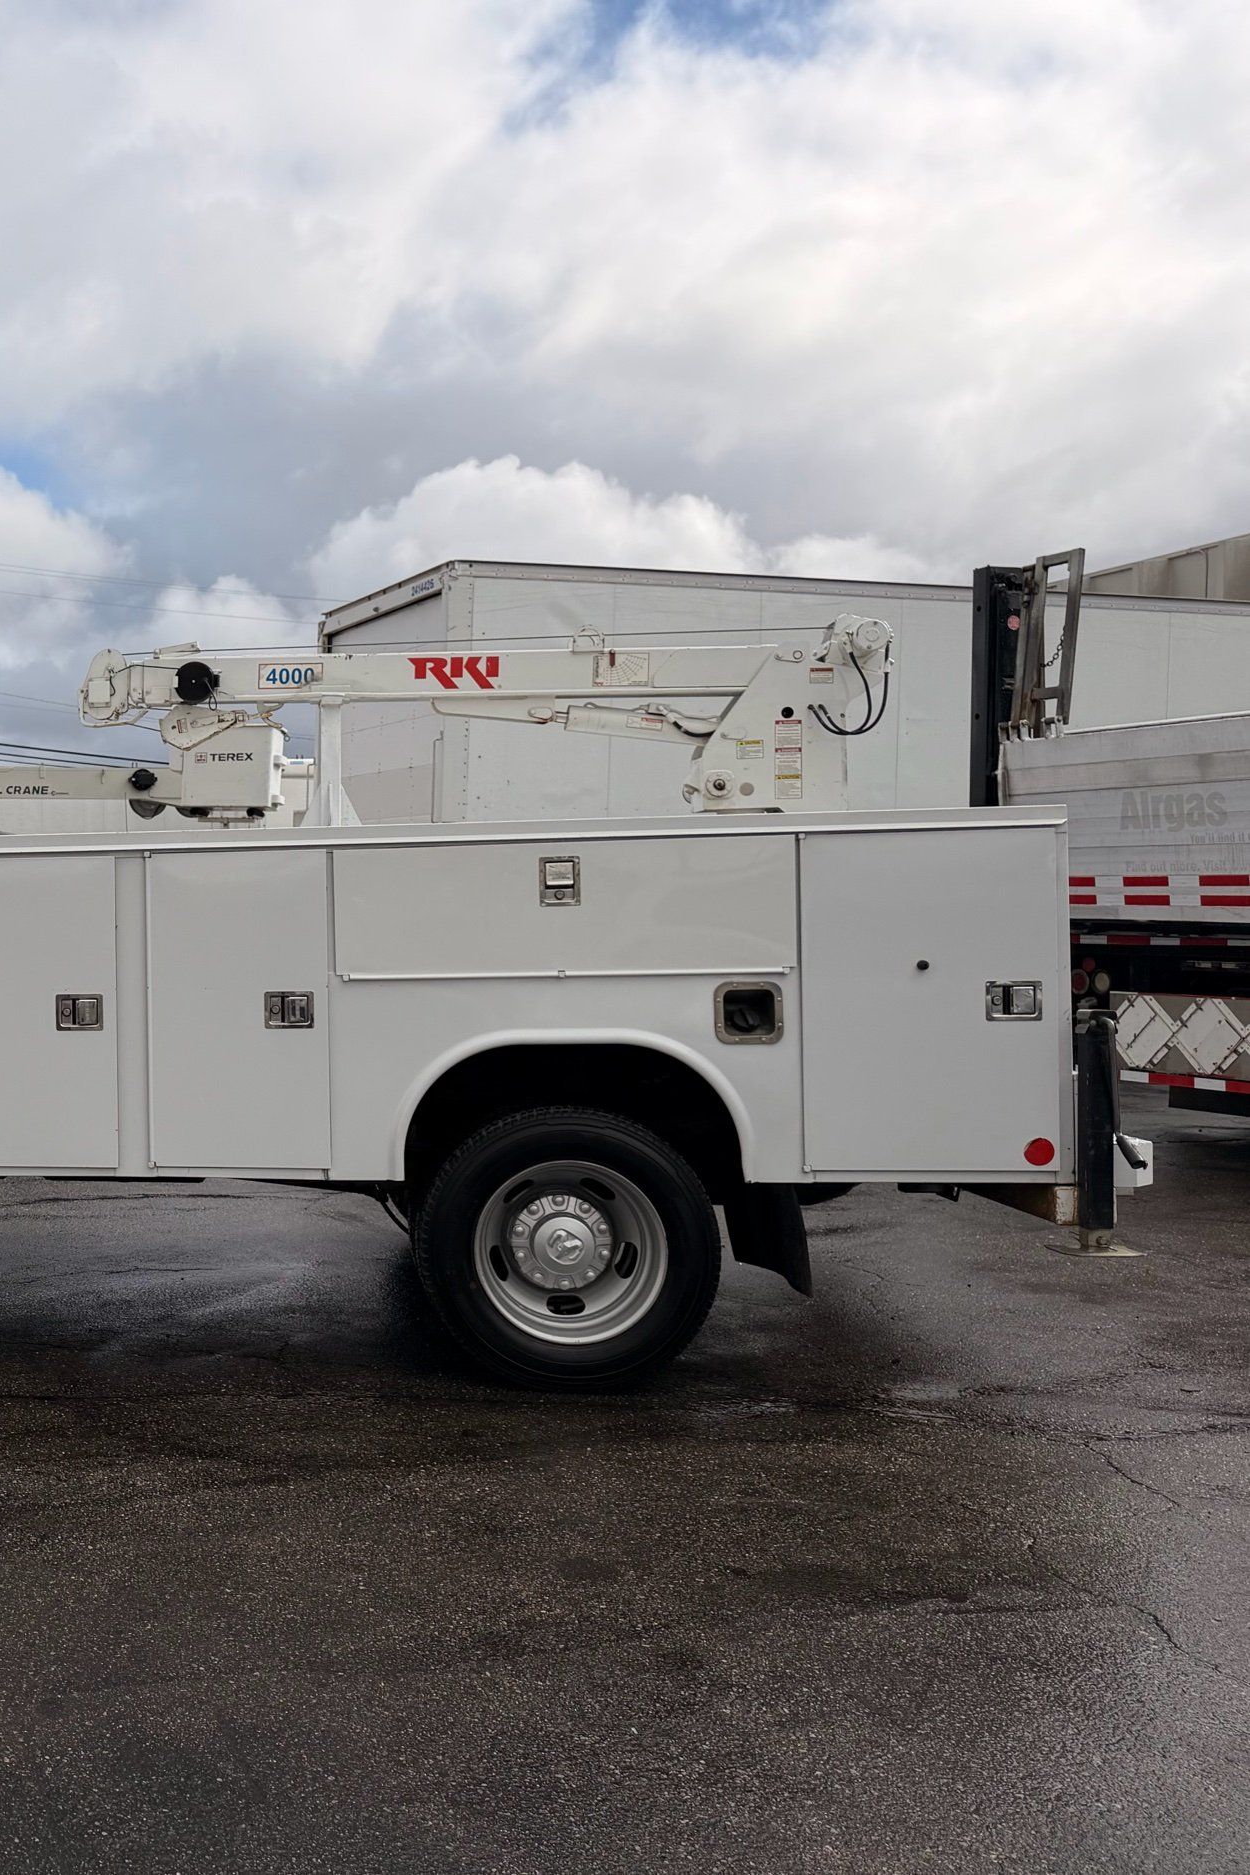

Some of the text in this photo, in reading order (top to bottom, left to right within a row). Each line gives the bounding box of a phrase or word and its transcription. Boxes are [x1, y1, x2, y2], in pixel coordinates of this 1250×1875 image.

[265, 667, 315, 685] 4000
[406, 656, 499, 690] RKI
[210, 752, 254, 762] TEREX
[6, 785, 49, 795] CRANE
[1119, 791, 1229, 833] Airgas
